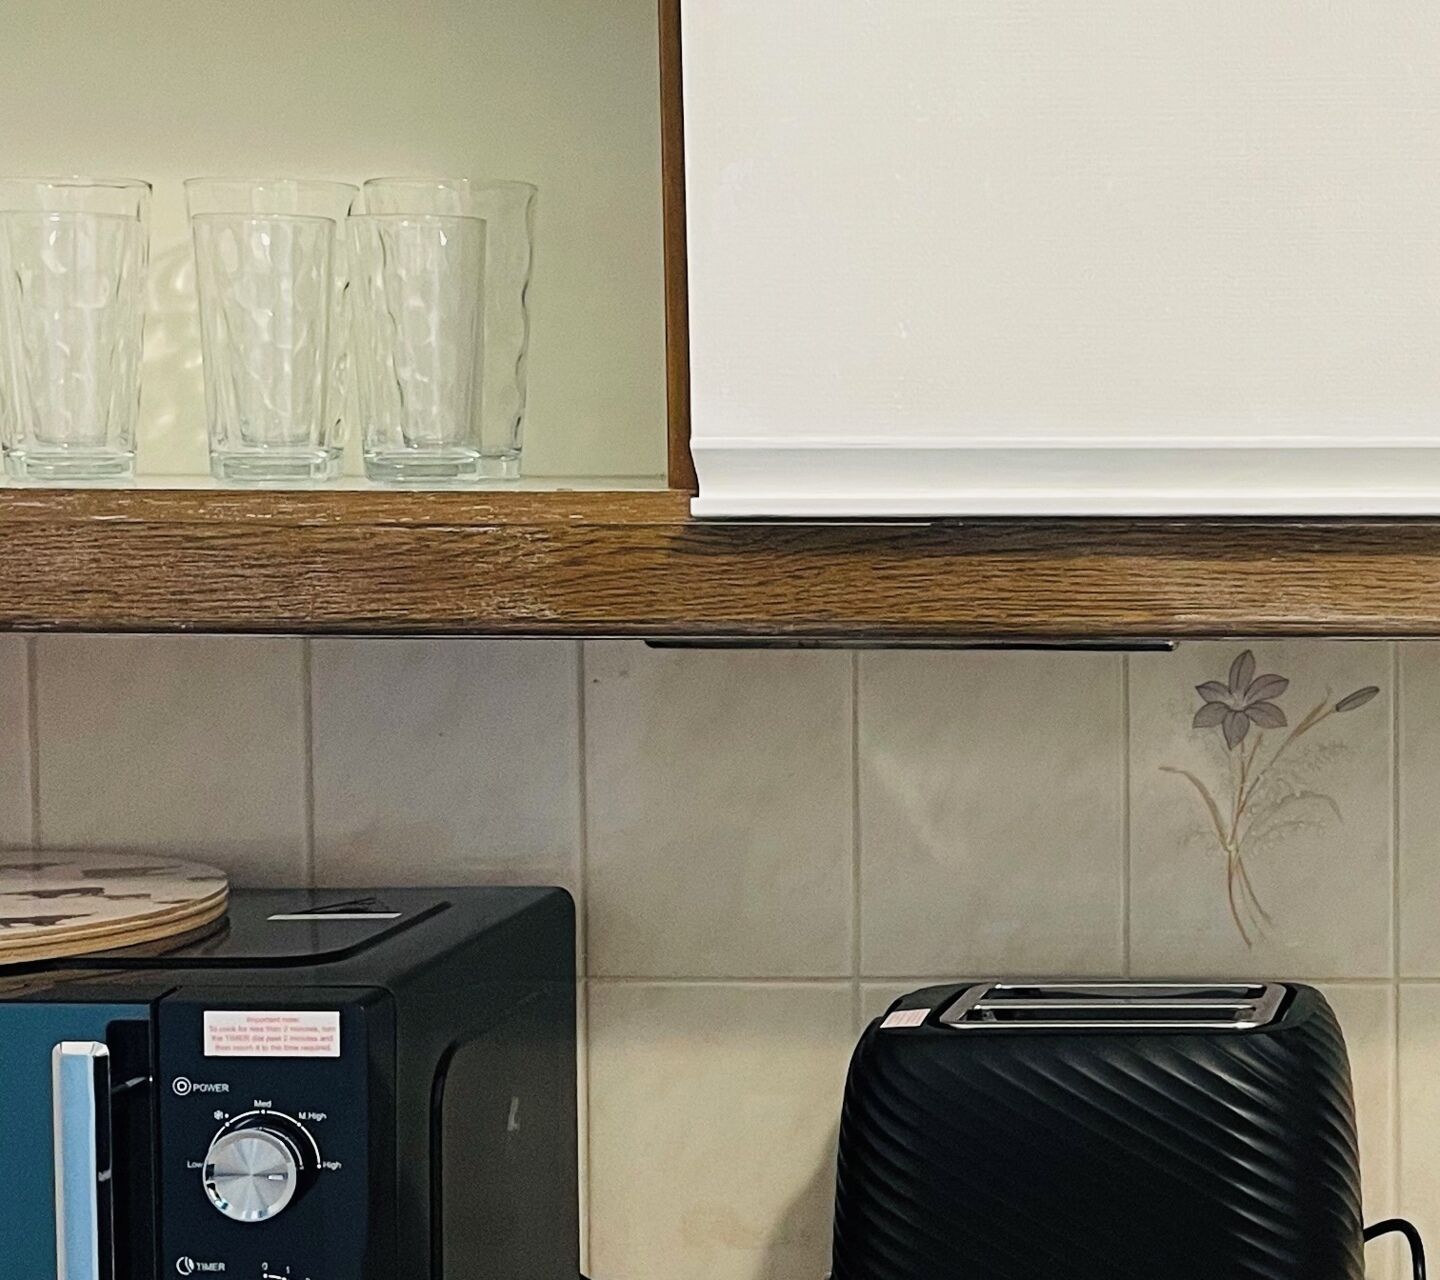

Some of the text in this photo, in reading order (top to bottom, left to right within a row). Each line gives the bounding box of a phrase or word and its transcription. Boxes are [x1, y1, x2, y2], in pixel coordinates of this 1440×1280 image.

[193, 1083, 230, 1093] POWER
[253, 1099, 272, 1108] Med
[322, 1160, 342, 1170] High
[196, 1262, 226, 1272] TIMER
[261, 1261, 269, 1271] 0
[285, 1265, 291, 1275] 1
